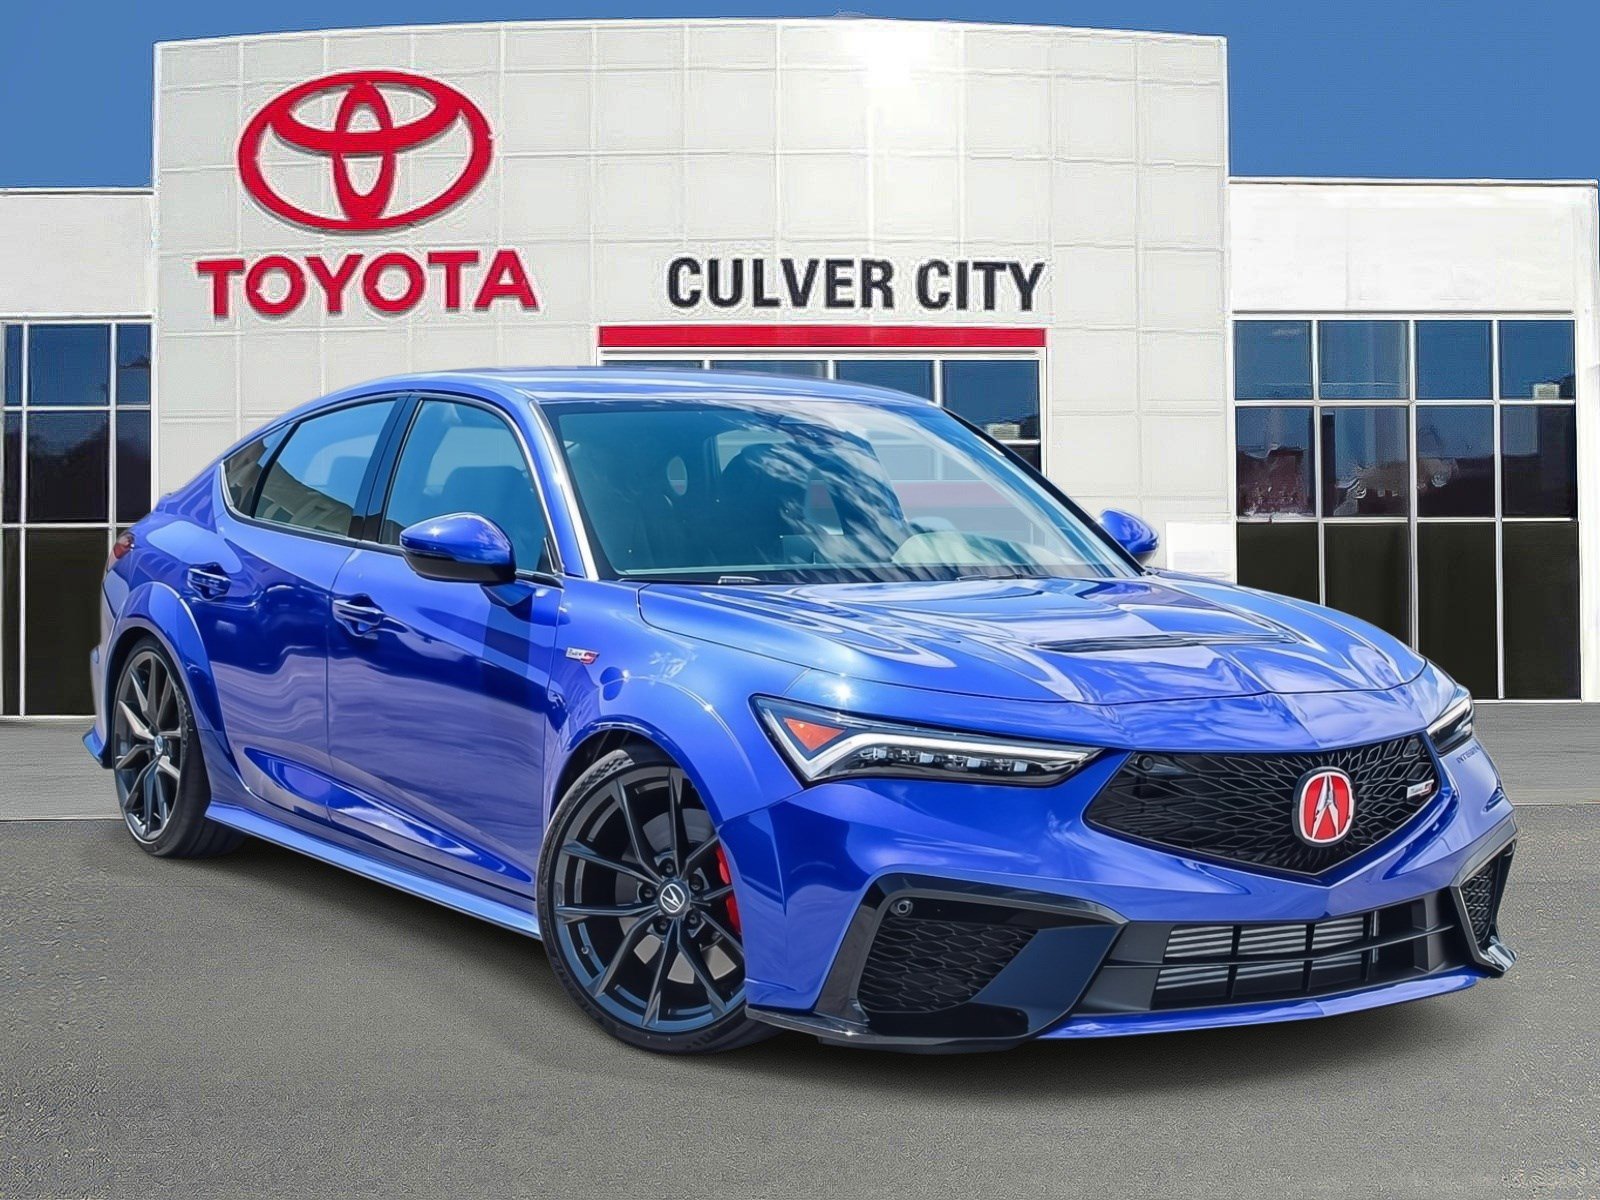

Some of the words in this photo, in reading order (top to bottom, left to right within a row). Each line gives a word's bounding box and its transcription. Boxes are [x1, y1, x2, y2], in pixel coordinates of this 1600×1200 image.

[195, 250, 539, 317] TOYOTA
[668, 257, 894, 309] CULVER
[916, 258, 1045, 311] CITY
